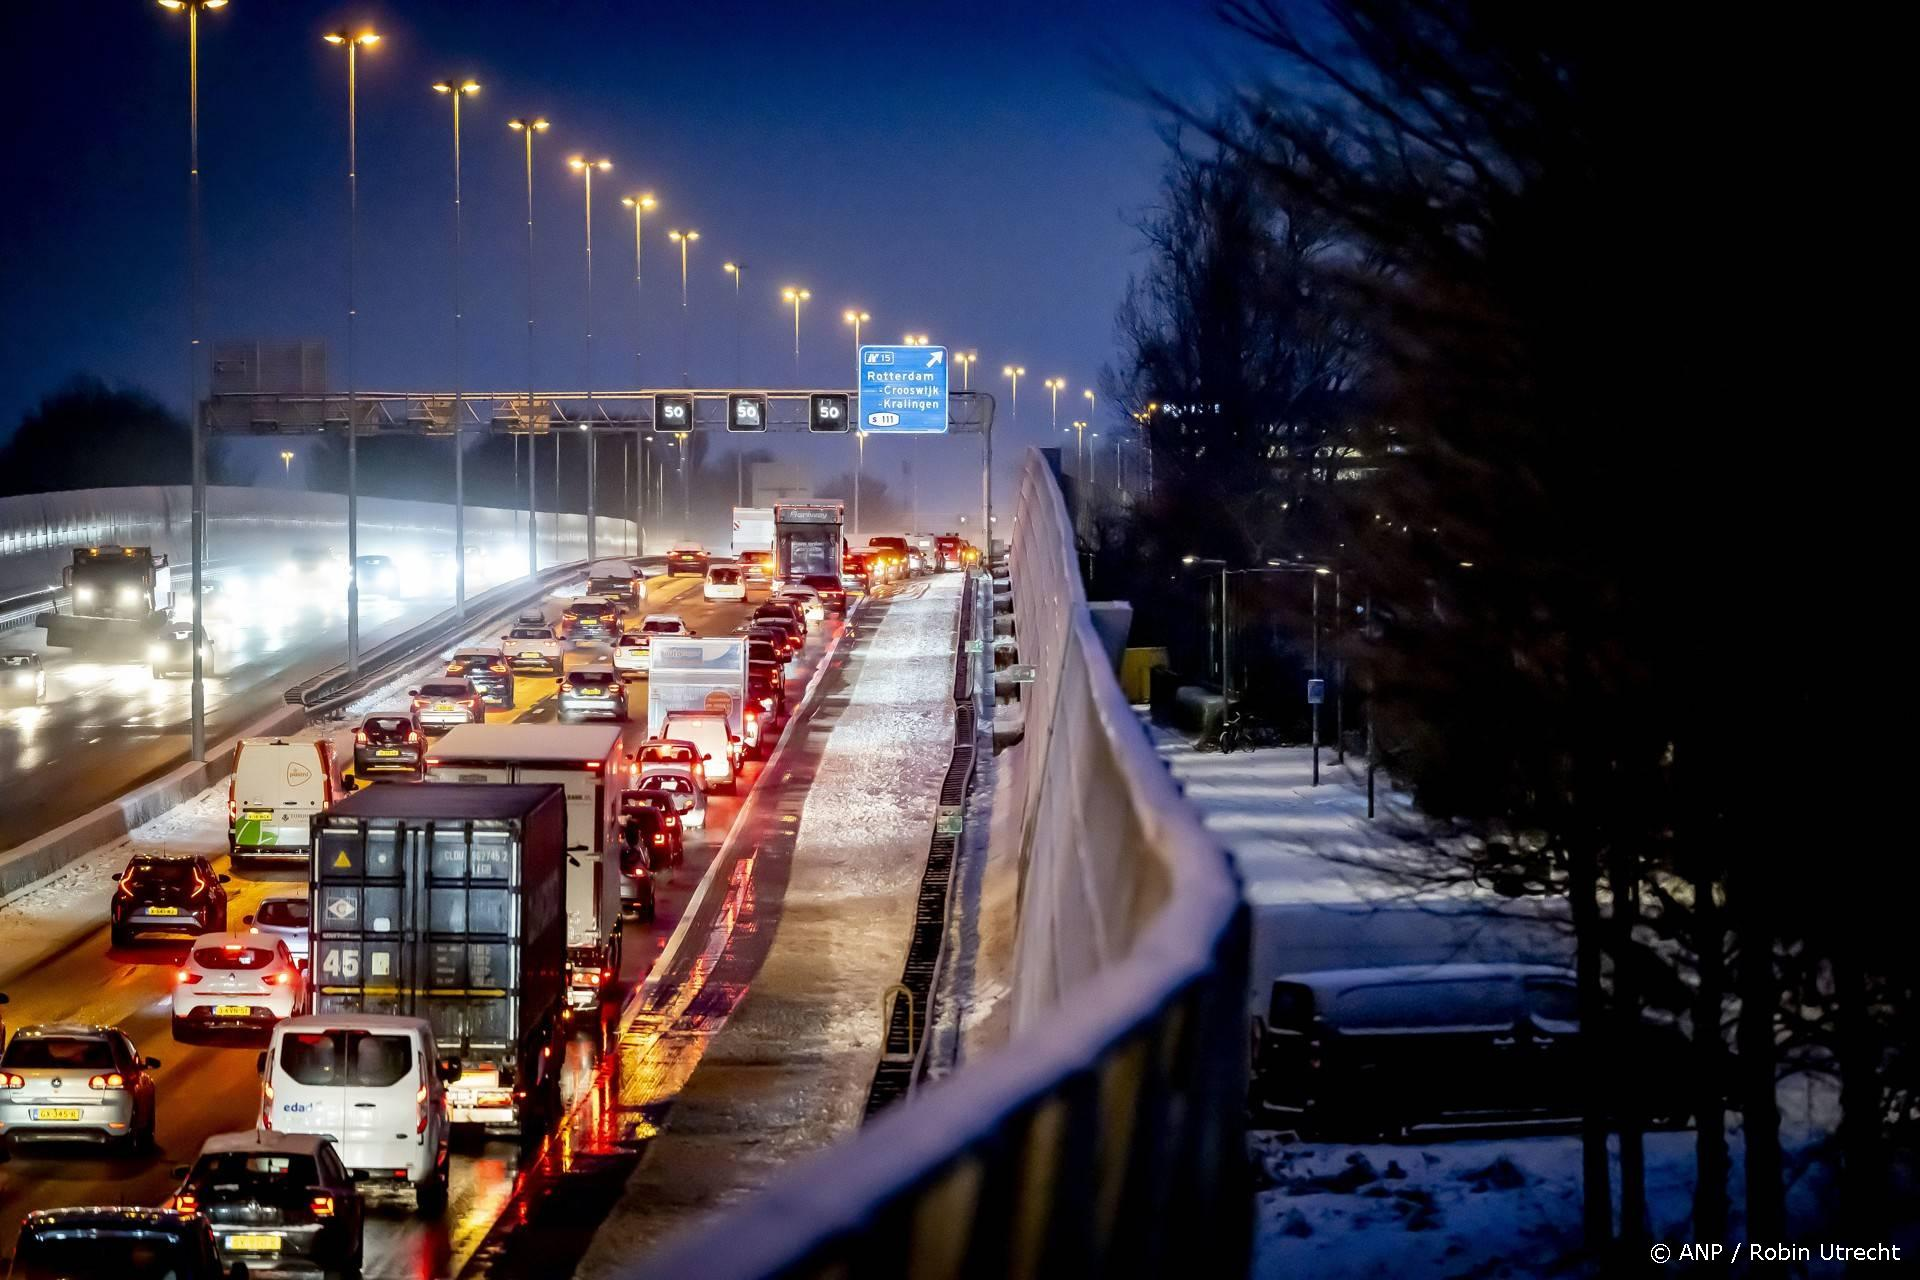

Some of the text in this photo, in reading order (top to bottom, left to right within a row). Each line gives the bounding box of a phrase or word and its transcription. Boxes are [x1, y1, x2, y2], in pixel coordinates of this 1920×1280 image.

[881, 354, 891, 362] 15
[867, 371, 934, 381] Rotterdam
[664, 405, 683, 418] 50
[737, 405, 757, 418] 50
[820, 406, 840, 419] 50
[882, 415, 894, 423] 111
[323, 949, 359, 977] 45
